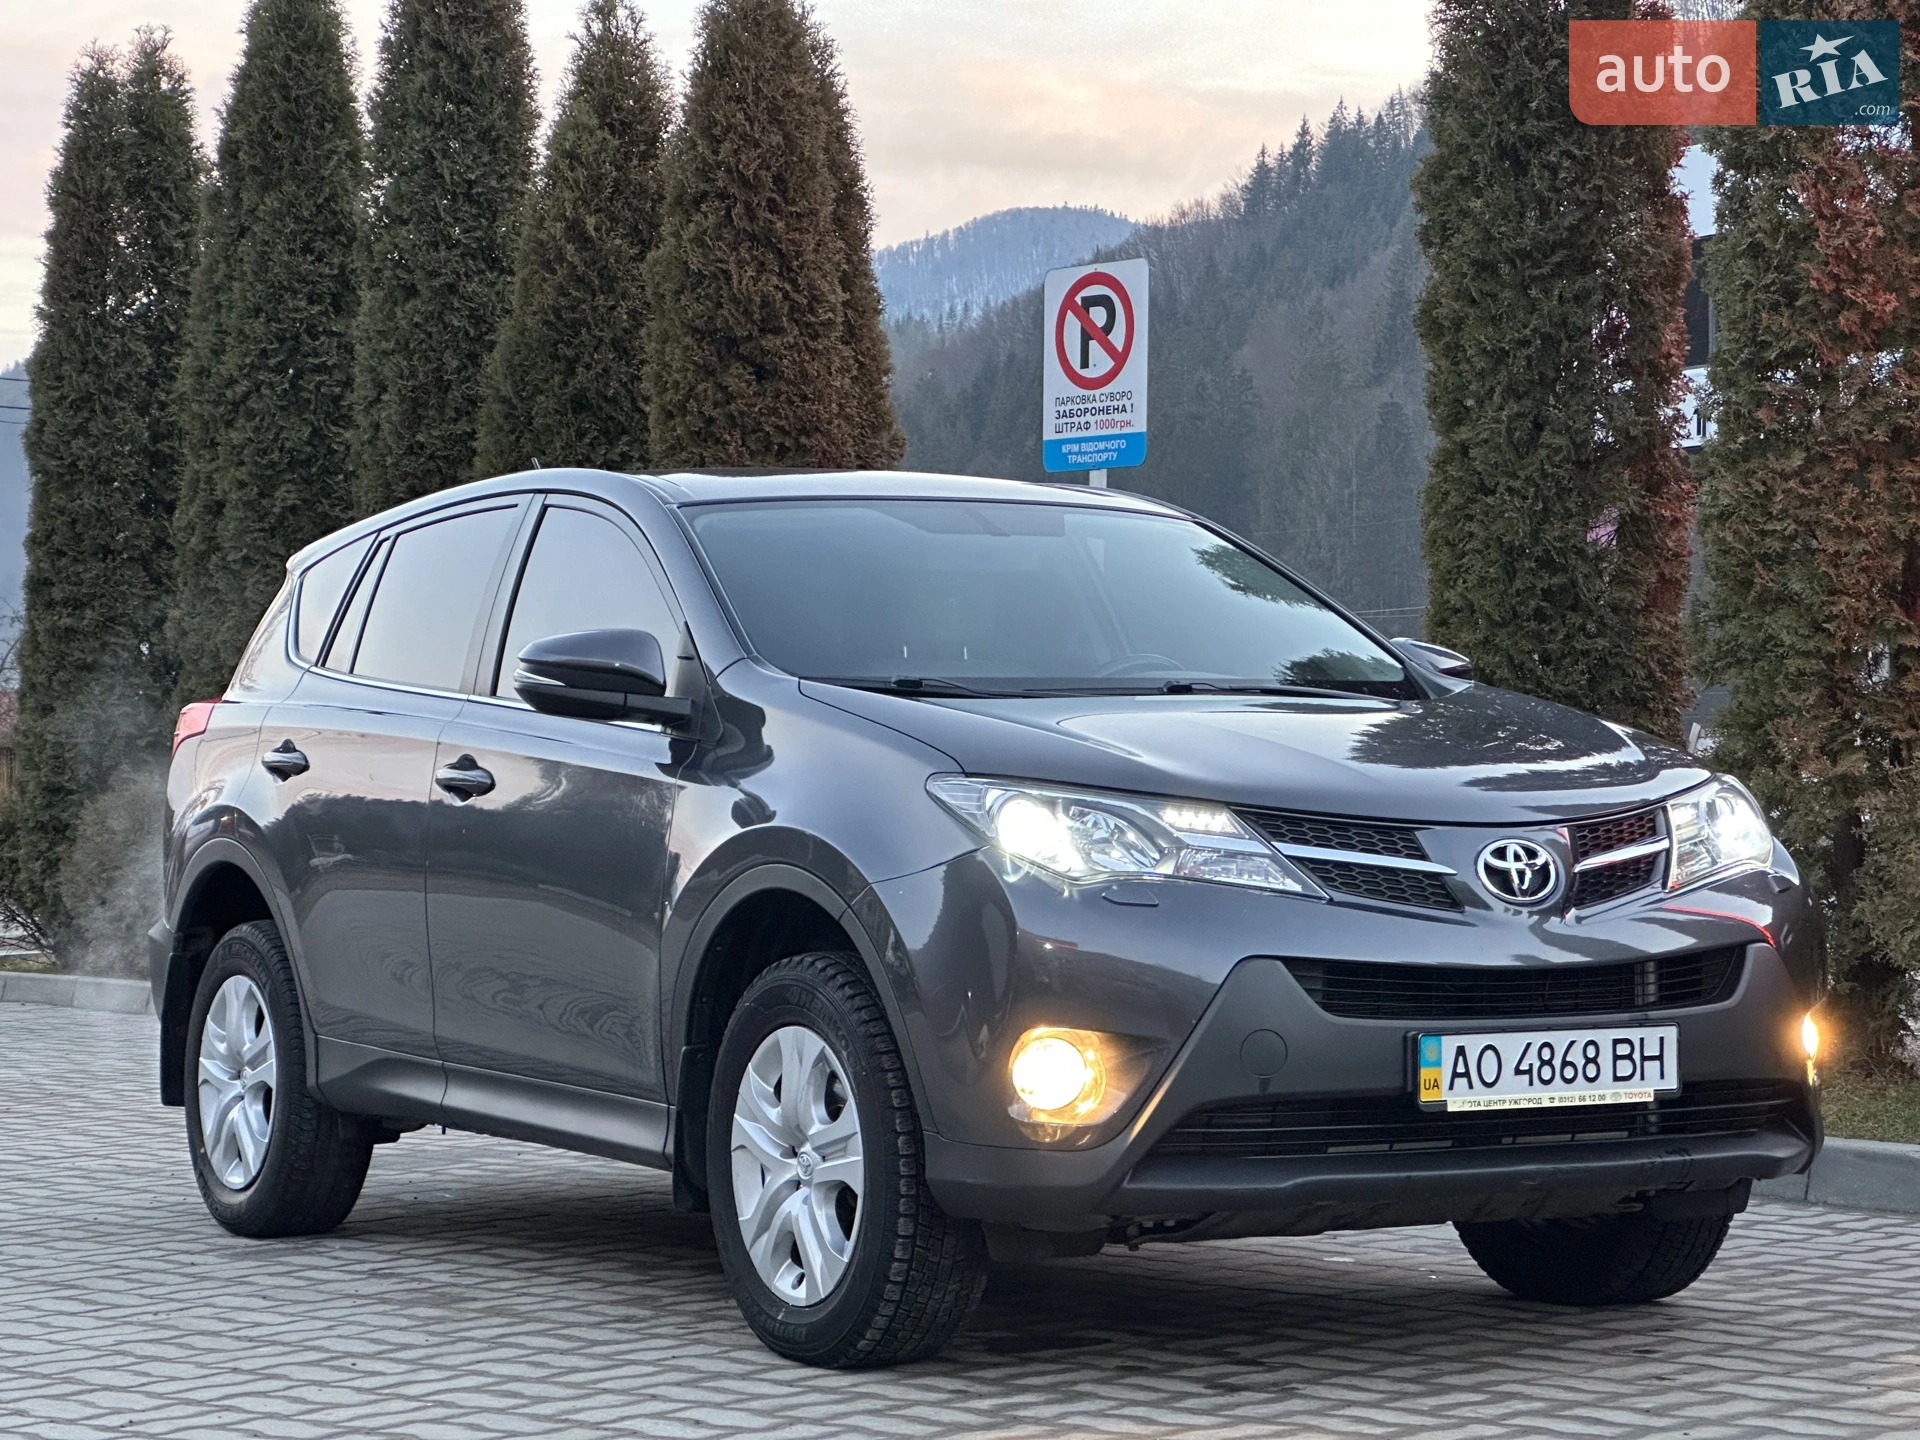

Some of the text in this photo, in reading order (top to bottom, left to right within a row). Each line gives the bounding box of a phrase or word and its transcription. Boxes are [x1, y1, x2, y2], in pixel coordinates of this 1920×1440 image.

[1055, 390, 1133, 407] ПАРКОВКА СУВОРО
[1054, 404, 1128, 420] ЗАБОРОНЕНА
[1054, 418, 1134, 434] ШТРАФ 1000грн.
[1061, 440, 1127, 453] КРІМ ВІДОМЧОГО
[1067, 451, 1118, 464] ТРАНСПОРТУ
[1448, 1036, 1665, 1091] AO 4868 BH
[1423, 1077, 1440, 1091] UA
[1483, 1099, 1507, 1108] ЦЕНТР
[1558, 1096, 1576, 1104] (0312)
[1588, 1094, 1597, 1102] 12
[1597, 1093, 1606, 1101] 00
[1623, 1091, 1652, 1100] TOYOTA
